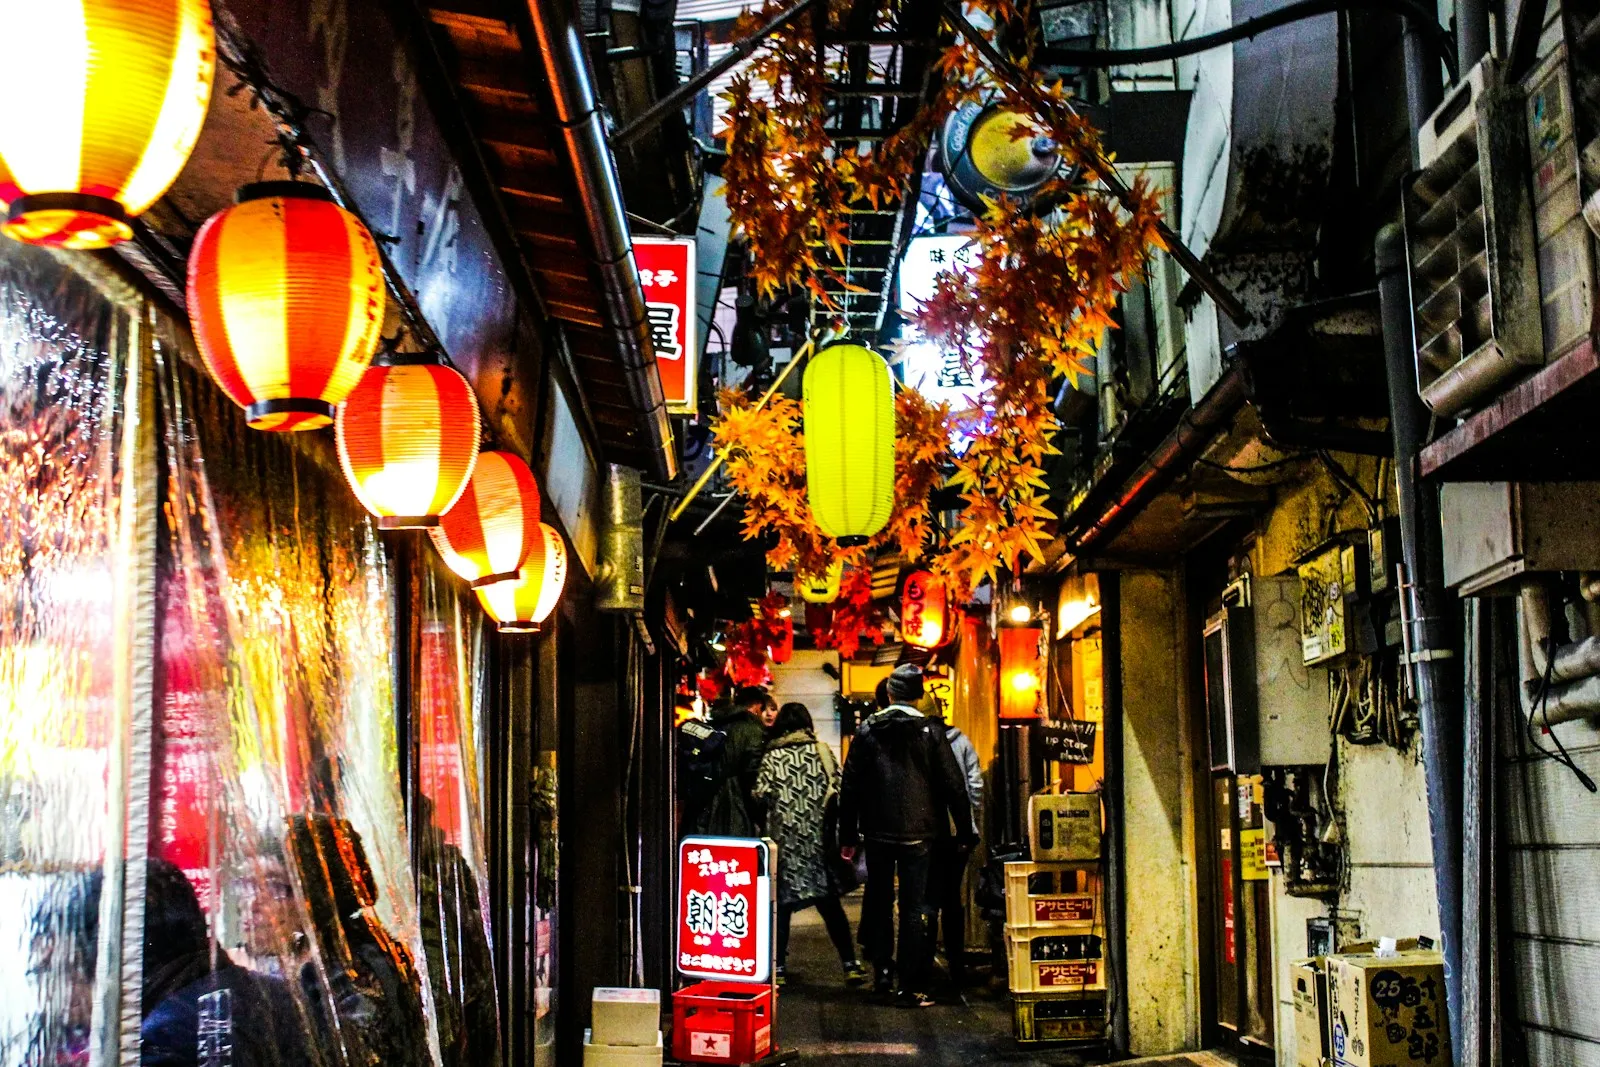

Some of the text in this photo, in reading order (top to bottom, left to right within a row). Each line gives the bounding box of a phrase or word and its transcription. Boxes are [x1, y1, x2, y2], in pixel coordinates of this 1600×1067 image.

[906, 580, 924, 637] もつ焼
[1035, 899, 1092, 912] アサヒビール
[1039, 964, 1097, 977] アサヒビール
[1375, 979, 1401, 998] 25
